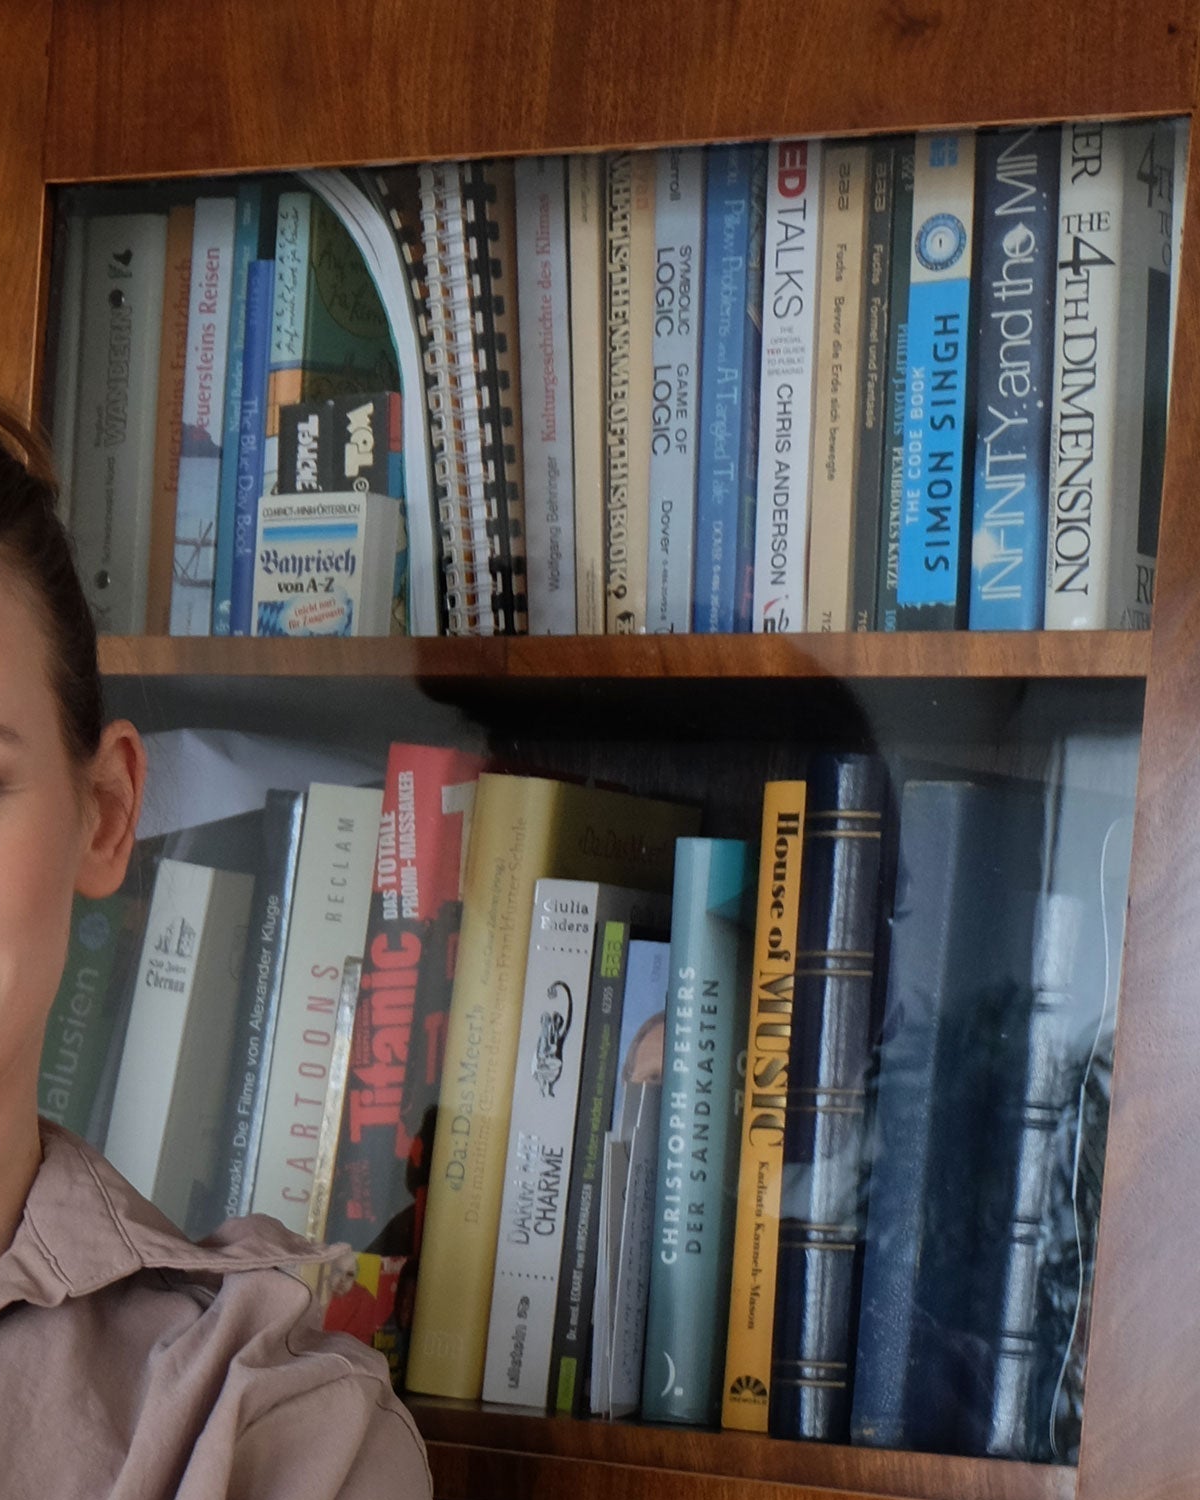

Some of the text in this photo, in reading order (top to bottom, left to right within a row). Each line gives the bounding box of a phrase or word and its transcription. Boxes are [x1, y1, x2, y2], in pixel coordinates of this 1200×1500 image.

[610, 237, 629, 263] IS
[722, 198, 744, 254] Pillow
[772, 198, 807, 321] TALKS
[1062, 209, 1111, 233] THE
[534, 192, 557, 441] Kulturgeschichte des Klimas
[609, 265, 629, 321] THE
[718, 255, 742, 337] Problems
[1056, 235, 1115, 323] 4TH
[191, 246, 220, 439] Feuersteins Reisen
[609, 322, 629, 398] NAME
[653, 247, 674, 456] LOGIC LOGIC
[674, 245, 690, 453] SYMBOLIC GAME OF
[716, 366, 739, 385] A
[826, 244, 846, 481] Fuchs Bevor die Erde sich bewegte
[865, 244, 883, 429] Fuchs Formel und Fantasie
[162, 378, 183, 493] Feuersteins
[609, 399, 629, 437] OF
[709, 390, 736, 460] Tangled
[905, 364, 927, 525] THE CODE BOOK
[923, 312, 961, 571] SIMON SINGH
[977, 220, 1037, 600] INFINITY and the
[1048, 324, 1101, 596] DIMENSION
[233, 396, 258, 557] The Blue Day Book
[608, 440, 629, 501] THIS
[712, 463, 734, 504] Tale
[768, 383, 794, 585] CHRIS ANDERSON
[261, 549, 356, 578] Bayrisch
[543, 455, 561, 591] Wolfgang Behringer
[659, 500, 672, 554] Dover
[277, 580, 305, 593] von
[377, 810, 398, 921] DAS TOTALE
[401, 770, 415, 920] PROMI-MASSAKER
[504, 814, 530, 873] Schule
[492, 873, 524, 970] Frankfurter
[233, 893, 281, 1147] Die Filme von Alexander Kluge
[276, 814, 357, 1205] CARTOONS RECLAM
[746, 810, 798, 1150] House of MUSIC
[351, 931, 422, 1144] Titanic
[485, 1028, 501, 1056] der
[450, 1087, 476, 1137] Das
[467, 1115, 494, 1190] maritime
[660, 965, 695, 1265] CHRISTOPH PETERS
[684, 978, 718, 1255] DER SANDKASTEN
[463, 1192, 481, 1223] Das
[532, 1143, 563, 1236] CHARME
[582, 1162, 595, 1180] Die
[745, 1222, 765, 1330] Kanneh-Mason
[505, 1323, 525, 1388] ullstein
